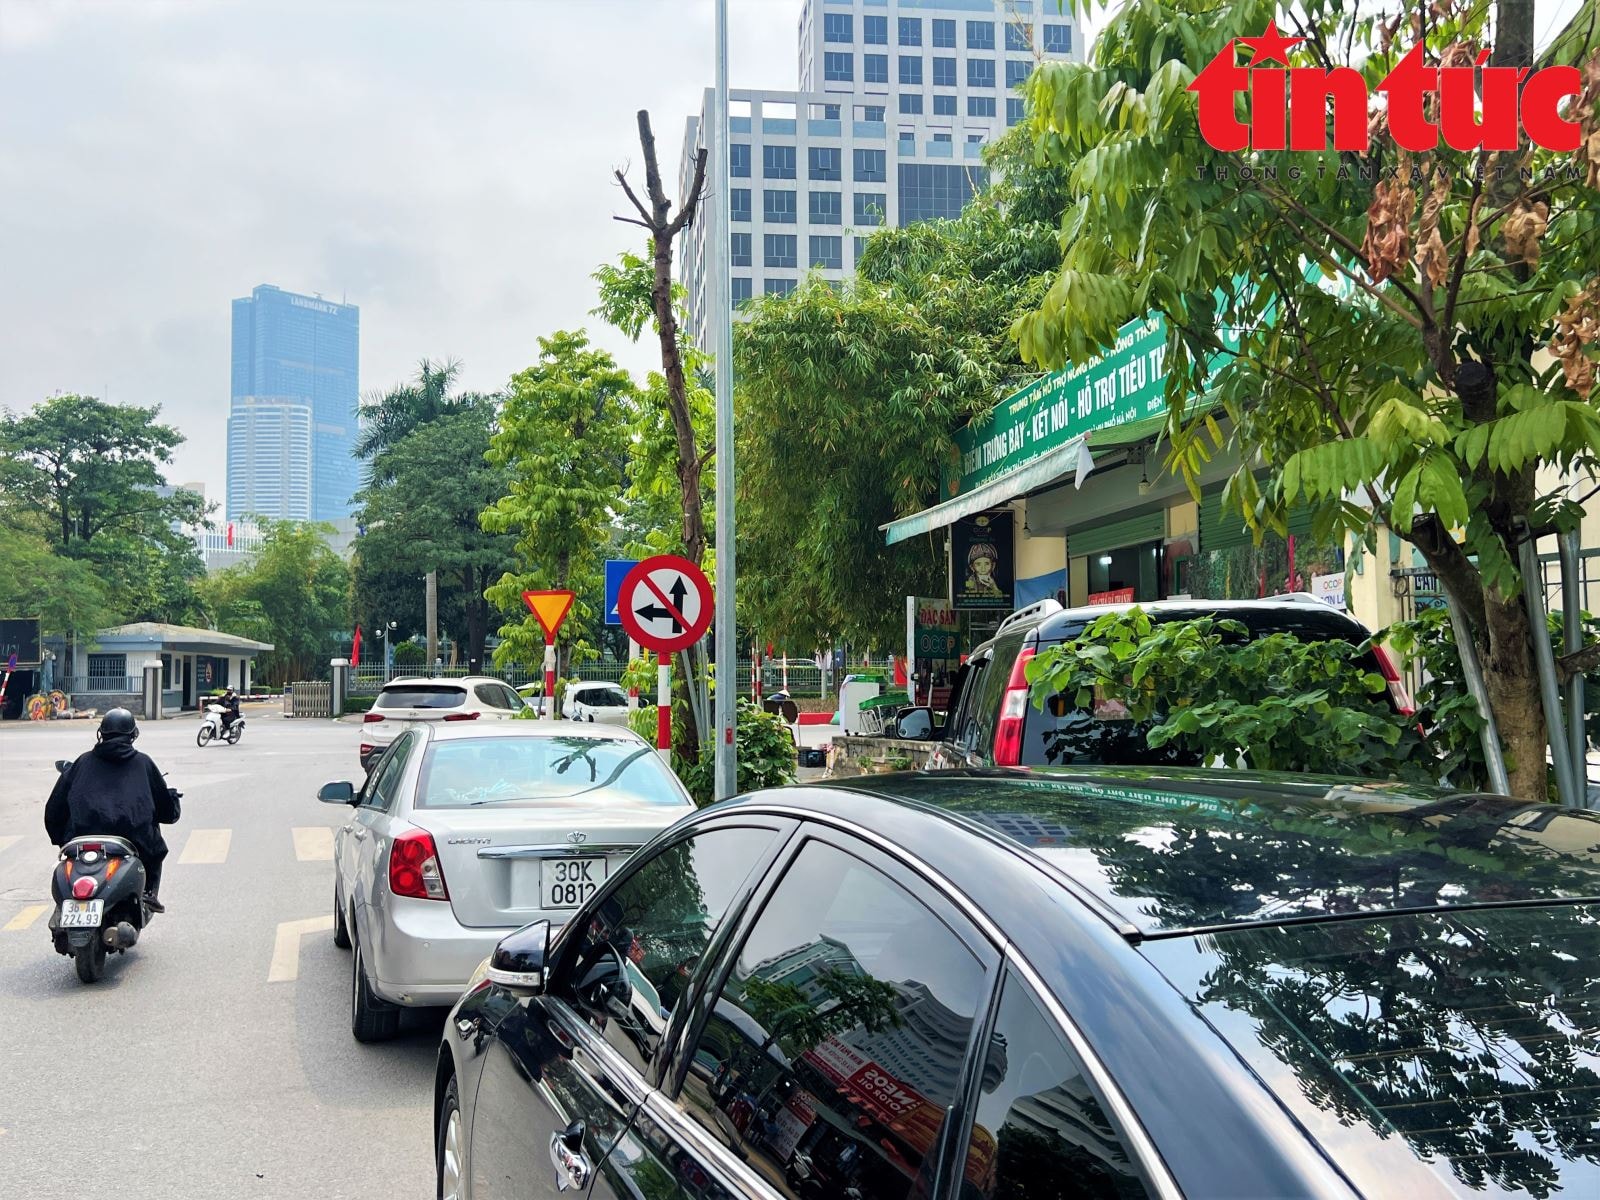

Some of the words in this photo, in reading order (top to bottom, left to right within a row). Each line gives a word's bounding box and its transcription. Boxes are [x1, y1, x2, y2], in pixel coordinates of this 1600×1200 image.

[1008, 419, 1025, 454] BÀY
[1032, 402, 1049, 442] KẾT
[1051, 389, 1069, 433] NỐI
[1077, 374, 1092, 420] HỖ
[1094, 368, 1117, 411] TRỢ
[1118, 353, 1147, 398] TIÊU
[920, 634, 956, 654] OCOP
[555, 860, 592, 882] 30K
[63, 914, 99, 926] 224.93
